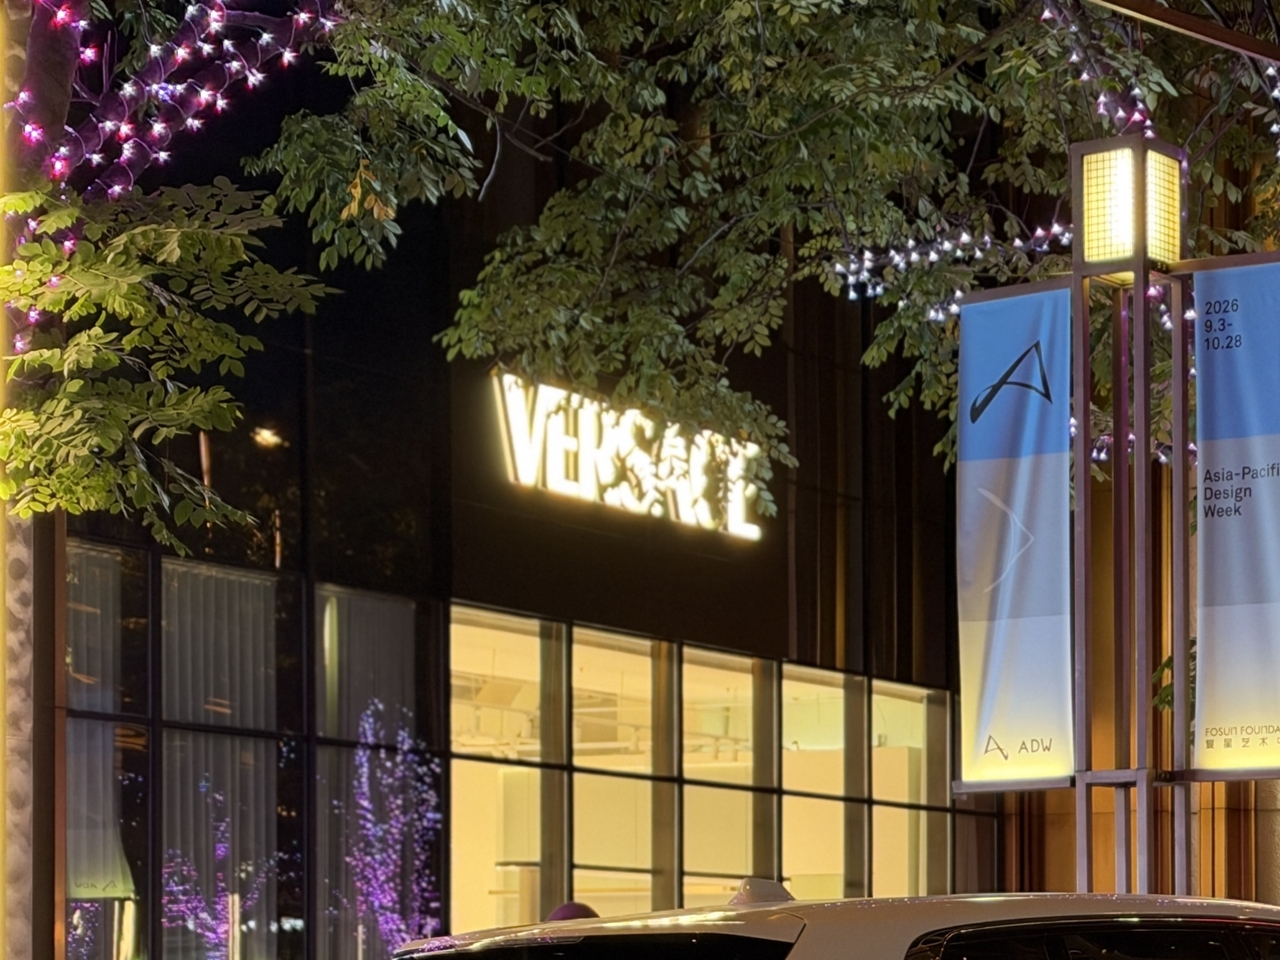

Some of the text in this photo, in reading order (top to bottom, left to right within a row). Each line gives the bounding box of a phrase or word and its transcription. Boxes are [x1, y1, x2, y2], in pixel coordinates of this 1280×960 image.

[1205, 299, 1239, 315] 2026
[1205, 318, 1233, 333] 9.3-
[1204, 335, 1242, 350] 10.28
[1204, 485, 1252, 503] Design
[1203, 502, 1242, 518] Week
[1018, 737, 1053, 754] ADW
